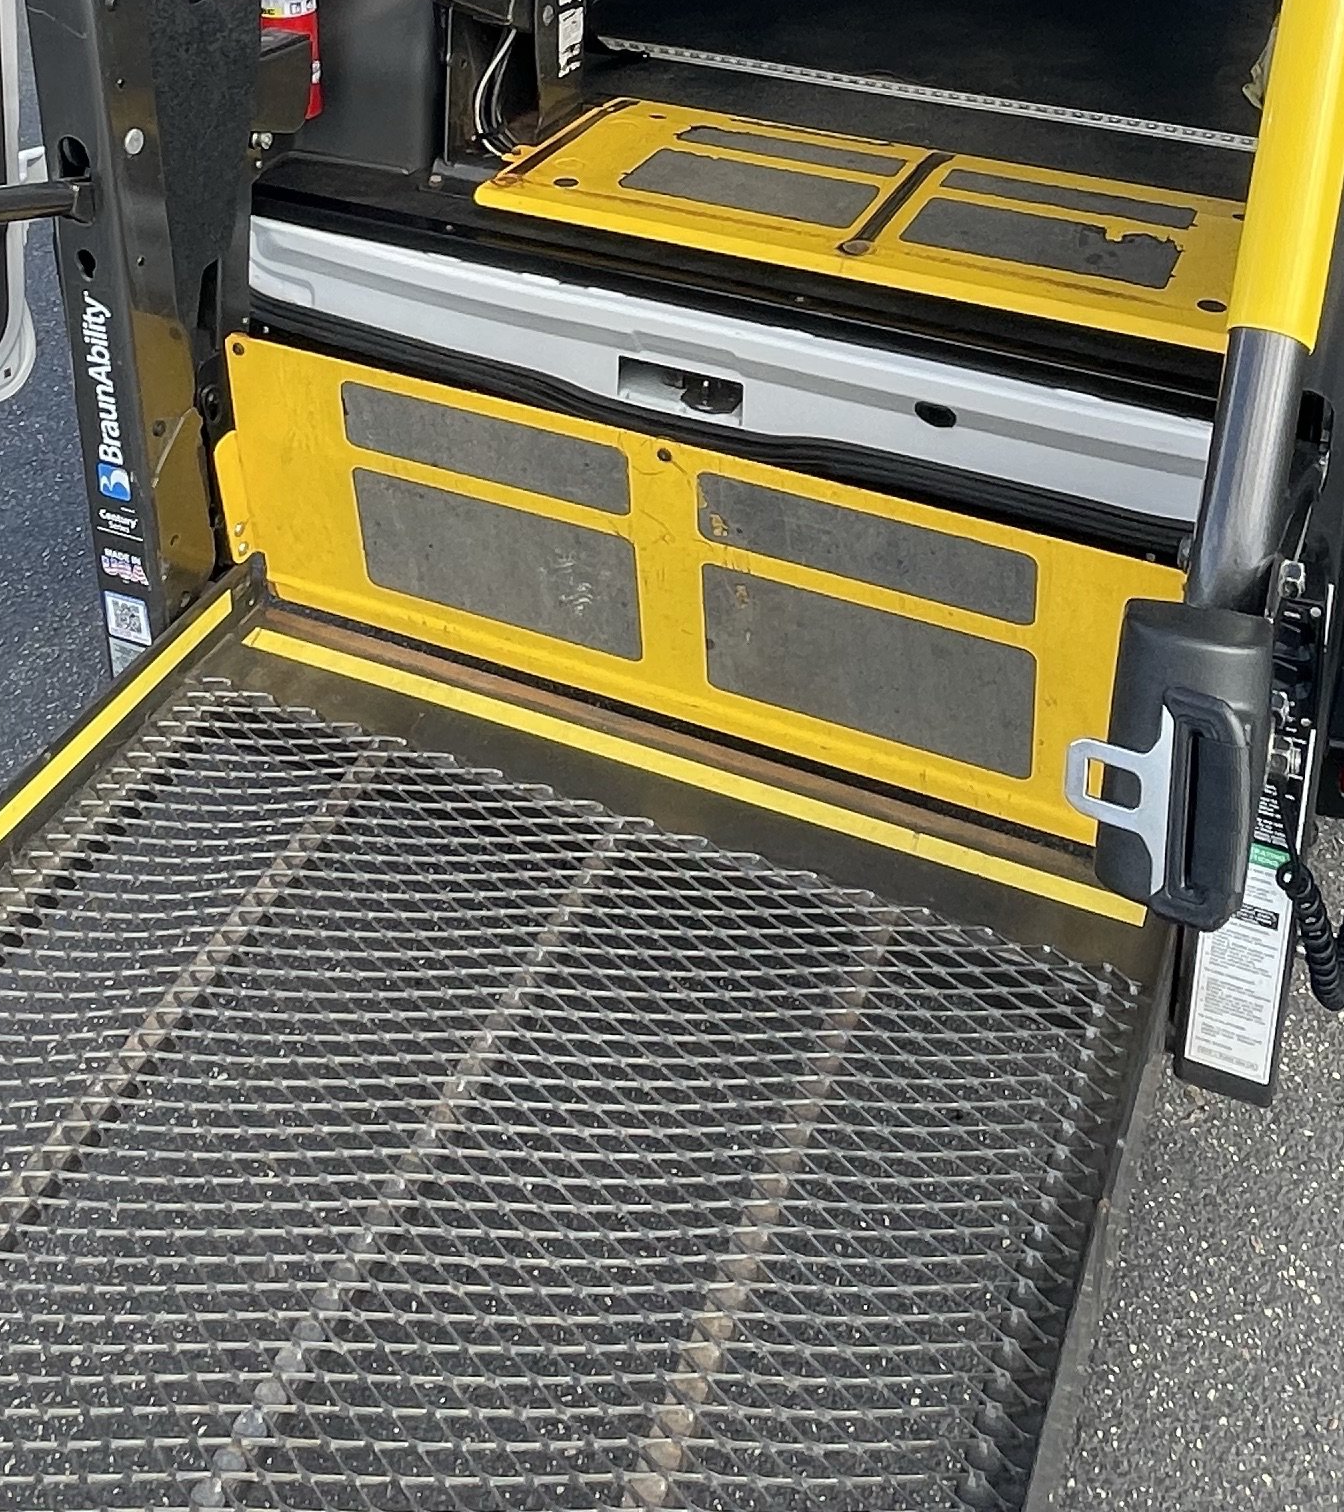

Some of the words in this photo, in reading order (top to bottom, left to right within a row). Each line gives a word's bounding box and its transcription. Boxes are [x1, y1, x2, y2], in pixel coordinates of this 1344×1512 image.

[82, 290, 124, 467] BraunAbility
[101, 554, 150, 587] USA
[103, 547, 131, 564] MADE
[130, 555, 142, 566] IN
